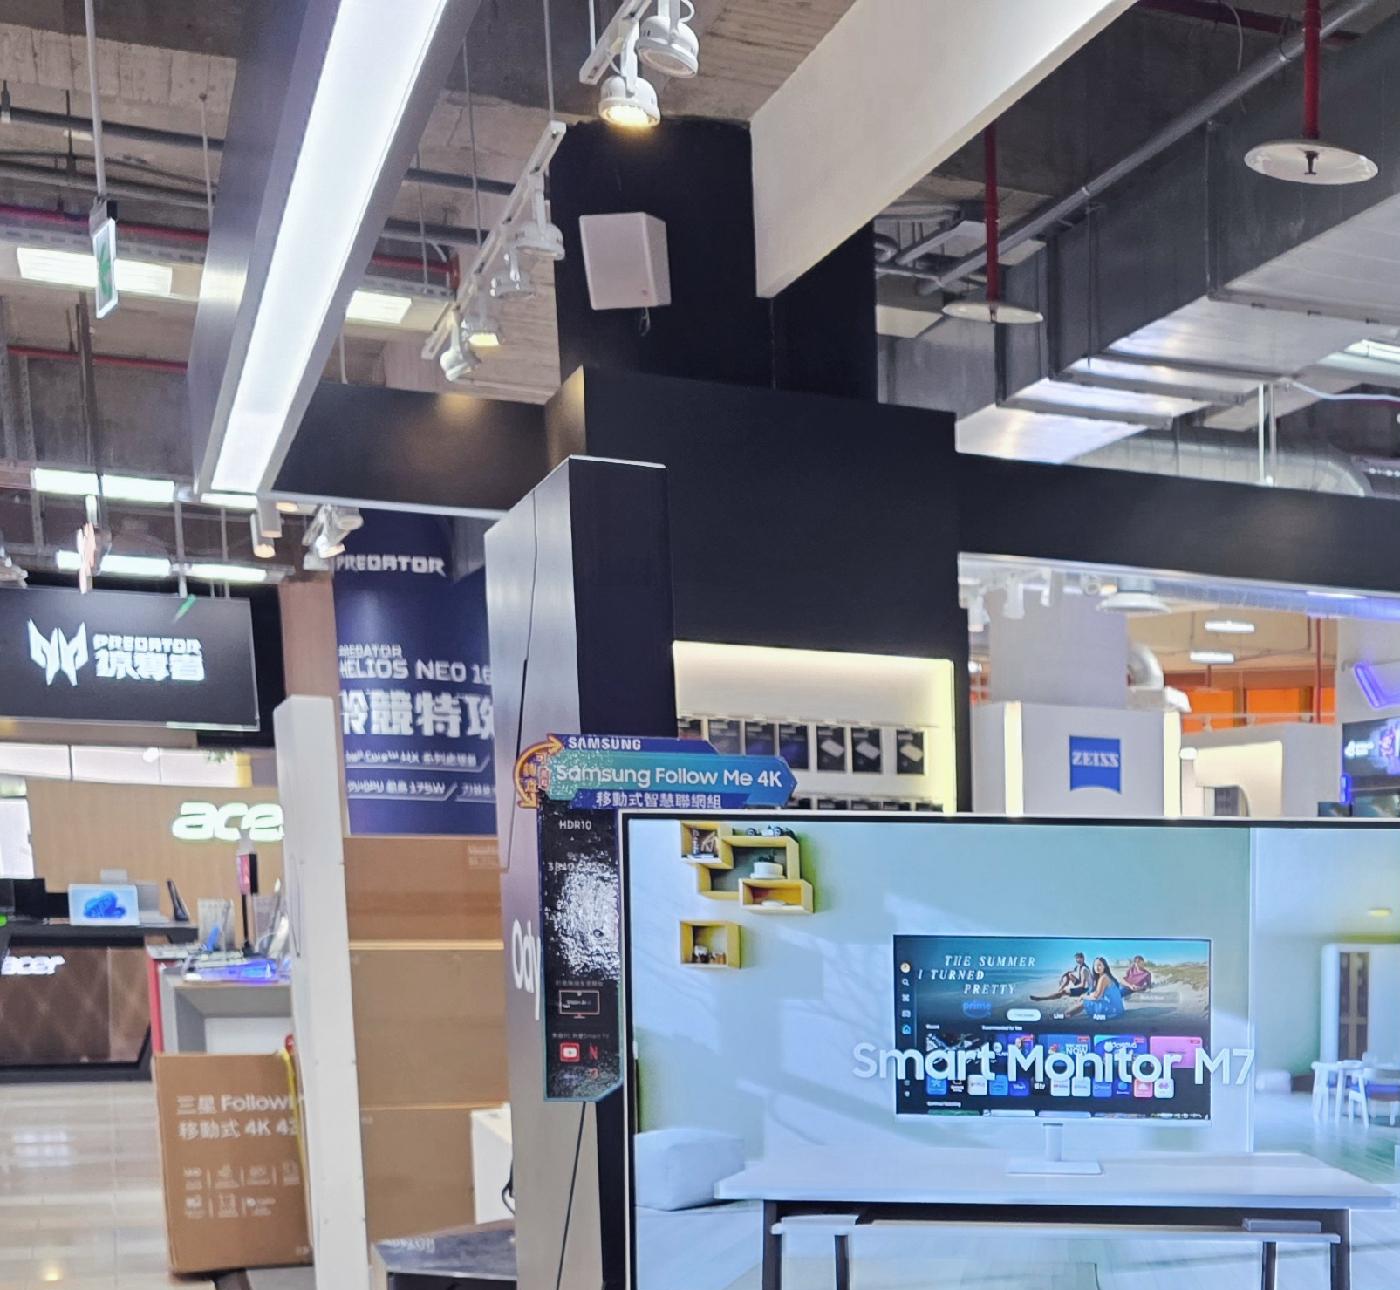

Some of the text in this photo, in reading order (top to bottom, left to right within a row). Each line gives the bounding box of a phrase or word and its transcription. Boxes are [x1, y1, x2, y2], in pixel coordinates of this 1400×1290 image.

[335, 555, 447, 577] PREDATOR
[92, 633, 202, 655] PREDATOR
[415, 659, 467, 682] NEO
[568, 736, 641, 750] SAMSUNG
[1072, 751, 1119, 768] ZEISS
[556, 765, 783, 788] Samsung Follow Me 4K
[172, 801, 284, 841] ace
[559, 820, 592, 831] HDR10
[945, 955, 1037, 968] THE SUMMER
[931, 969, 985, 981] TURNED
[963, 984, 1016, 995] PRETTY
[852, 1042, 1255, 1086] Smart Monitor M7
[244, 1119, 271, 1137] 4K
